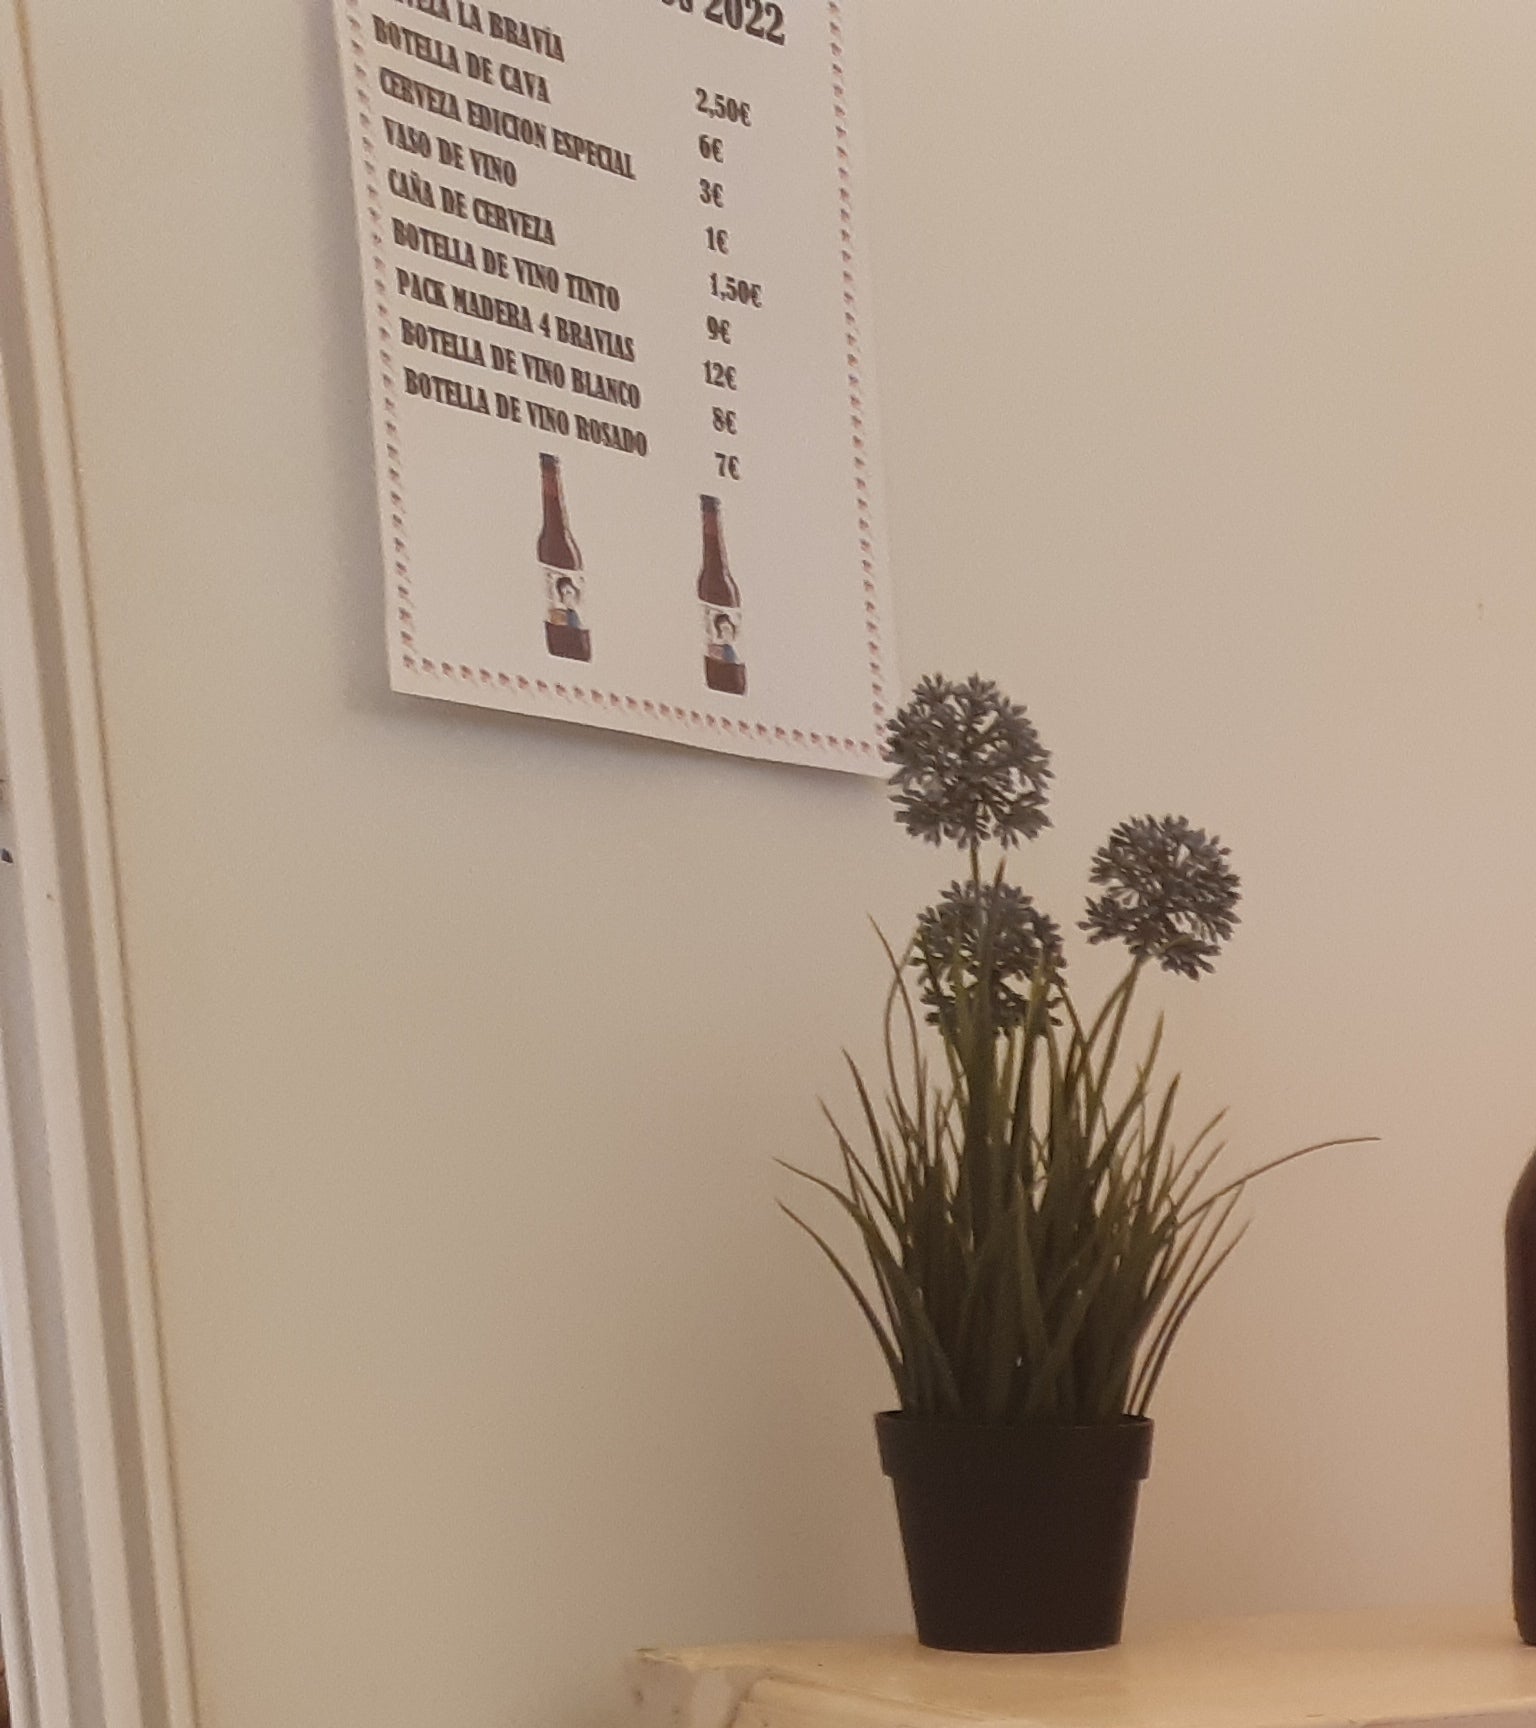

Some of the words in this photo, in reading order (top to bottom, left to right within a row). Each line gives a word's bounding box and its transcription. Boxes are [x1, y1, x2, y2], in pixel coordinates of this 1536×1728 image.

[457, 0, 484, 34] LA
[704, 0, 785, 46] 2022
[372, 14, 460, 74] BOTELLA
[464, 51, 493, 86] DE
[499, 61, 552, 104] CAVA
[379, 66, 462, 123] CERVEZA
[553, 127, 637, 181] ESPECIAL
[695, 87, 752, 128] 2,50€
[382, 116, 432, 159] VASO
[438, 135, 466, 170] DE
[469, 145, 518, 188] VINO
[698, 134, 724, 164] 6€
[388, 167, 436, 210] CAÑA
[440, 184, 469, 219] DE
[472, 196, 557, 248] CERVEZA
[699, 178, 725, 209] 3€
[705, 226, 730, 256] 1€
[391, 216, 477, 272] BOTELLA
[483, 247, 509, 278] DE
[513, 254, 560, 296] VINO
[564, 271, 622, 312] TINTO
[396, 266, 447, 310] PACK
[452, 284, 533, 334] MADERA
[539, 311, 551, 339] 4
[709, 272, 763, 309] 1,50€
[706, 315, 731, 346] 9€
[400, 317, 486, 369] BOTELLA
[490, 343, 518, 376] DE
[521, 352, 567, 391] VINO
[571, 367, 642, 410] BLANCO
[702, 359, 738, 391] 12€
[404, 366, 491, 417] BOTELLA
[495, 391, 523, 424] DE
[526, 400, 571, 437] VINO
[575, 413, 649, 459] ROSADO
[711, 406, 738, 436] 8€
[715, 452, 741, 481] 7€
